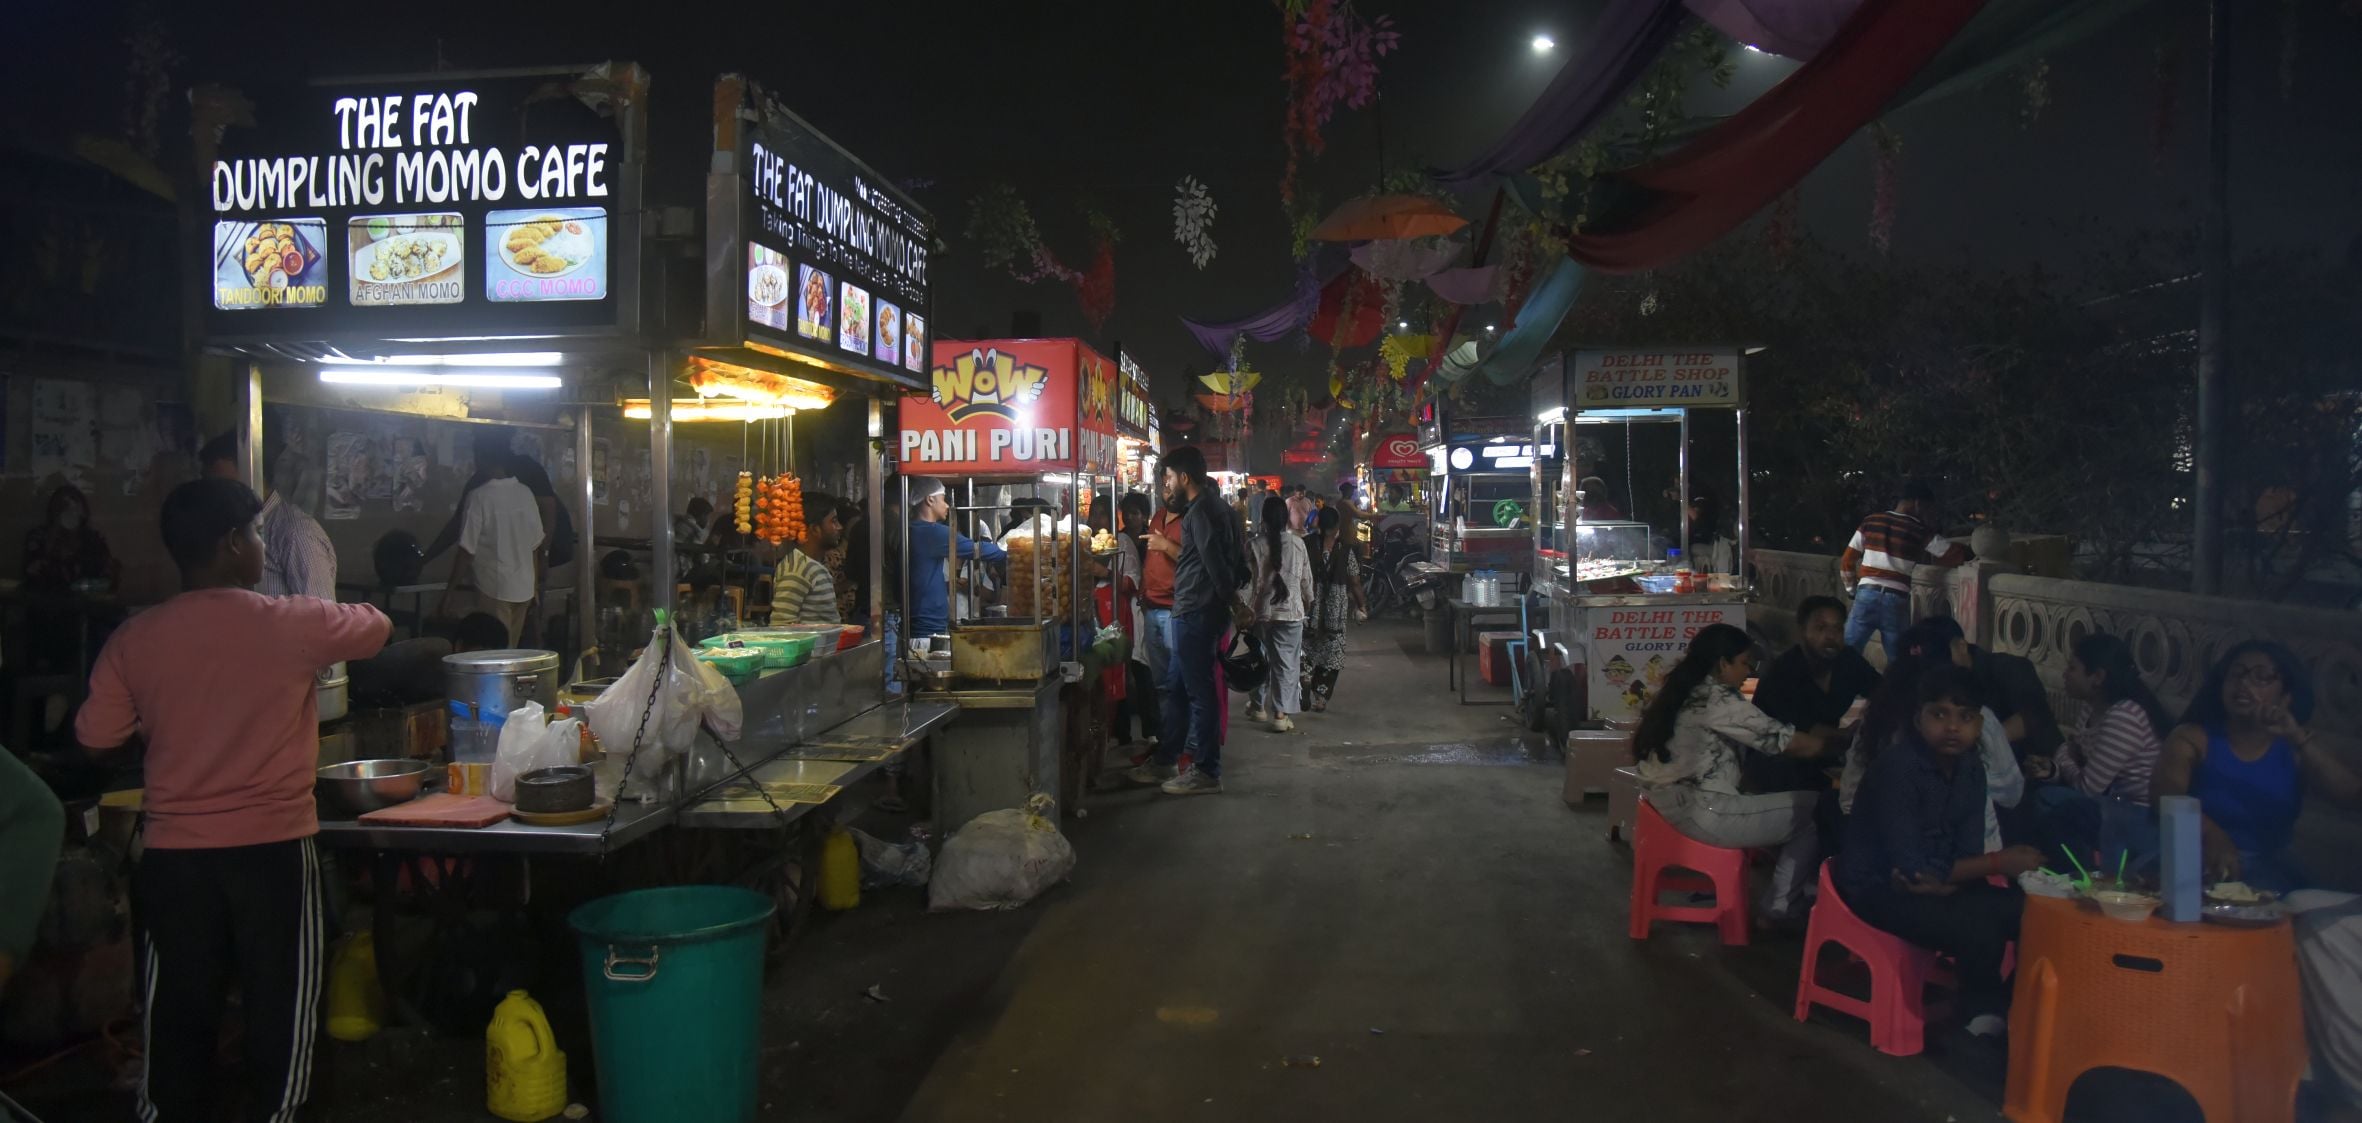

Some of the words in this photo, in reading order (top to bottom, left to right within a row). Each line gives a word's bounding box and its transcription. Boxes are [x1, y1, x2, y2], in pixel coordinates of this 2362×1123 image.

[335, 96, 402, 149] THE
[412, 92, 478, 145] FAT
[213, 153, 384, 211] DUMPLING
[398, 148, 506, 204] MOMO
[517, 143, 608, 199] CAFE
[753, 143, 784, 209] THE
[788, 164, 813, 222] FAT
[816, 181, 874, 256] DUMPLING
[876, 220, 905, 275] MOMO
[907, 239, 927, 286] CAFE
[762, 205, 793, 247] Taking
[219, 287, 284, 305] TANDOORI
[286, 285, 326, 304] MOMO
[355, 283, 414, 301] AFGHANI
[418, 281, 460, 299] MOMO
[540, 278, 597, 296] MOMO
[1601, 354, 1665, 368] DELHI
[1672, 353, 1714, 366] THE
[1585, 369, 1667, 383] BATTLE
[1673, 367, 1730, 381] SHOP
[1611, 384, 1666, 399] GLORY
[1669, 384, 1704, 398] PAN
[900, 429, 976, 462] PANI
[990, 427, 1069, 461] PURI
[1080, 427, 1098, 464] PANI
[1610, 611, 1675, 624] DELHI
[1681, 610, 1724, 624] THE
[1595, 626, 1677, 640] BATTLE
[1625, 642, 1675, 652] GLORY
